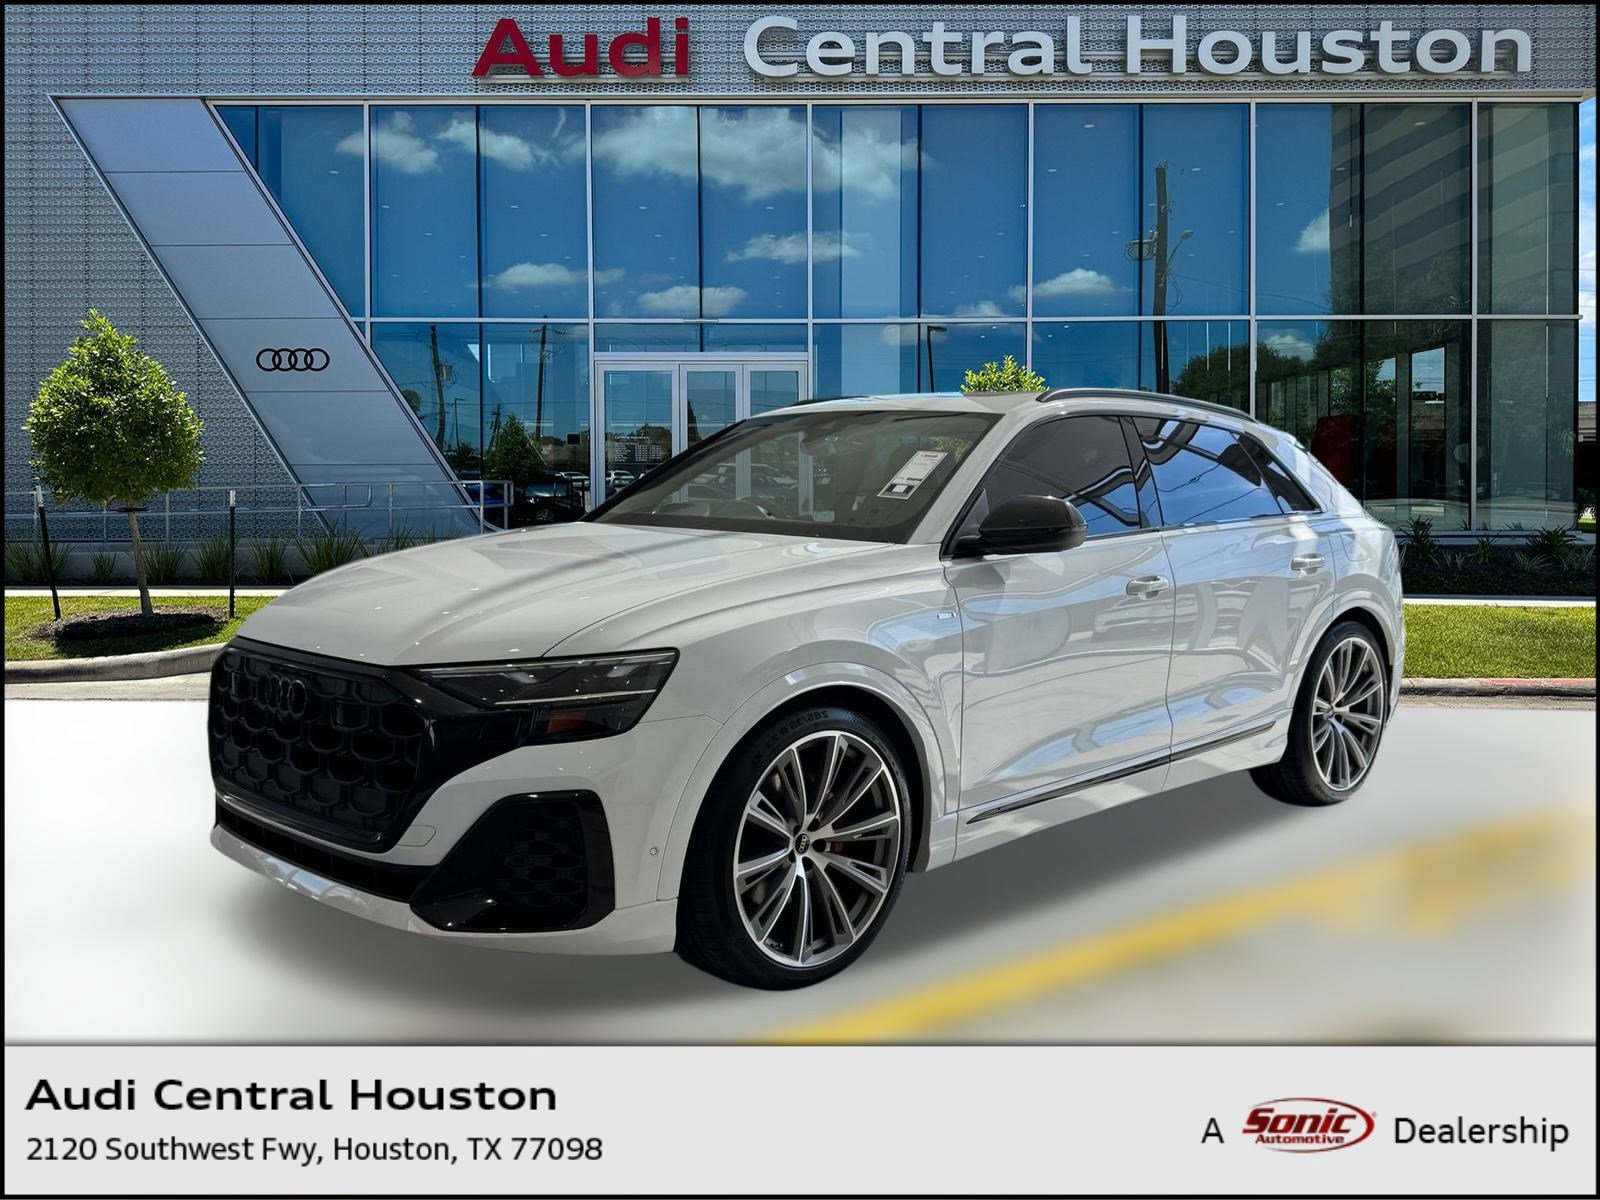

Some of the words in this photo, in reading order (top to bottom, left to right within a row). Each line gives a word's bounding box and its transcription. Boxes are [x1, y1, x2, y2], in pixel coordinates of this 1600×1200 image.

[472, 17, 690, 78] Audi
[743, 15, 1093, 78] Central
[1127, 15, 1532, 77] Houston
